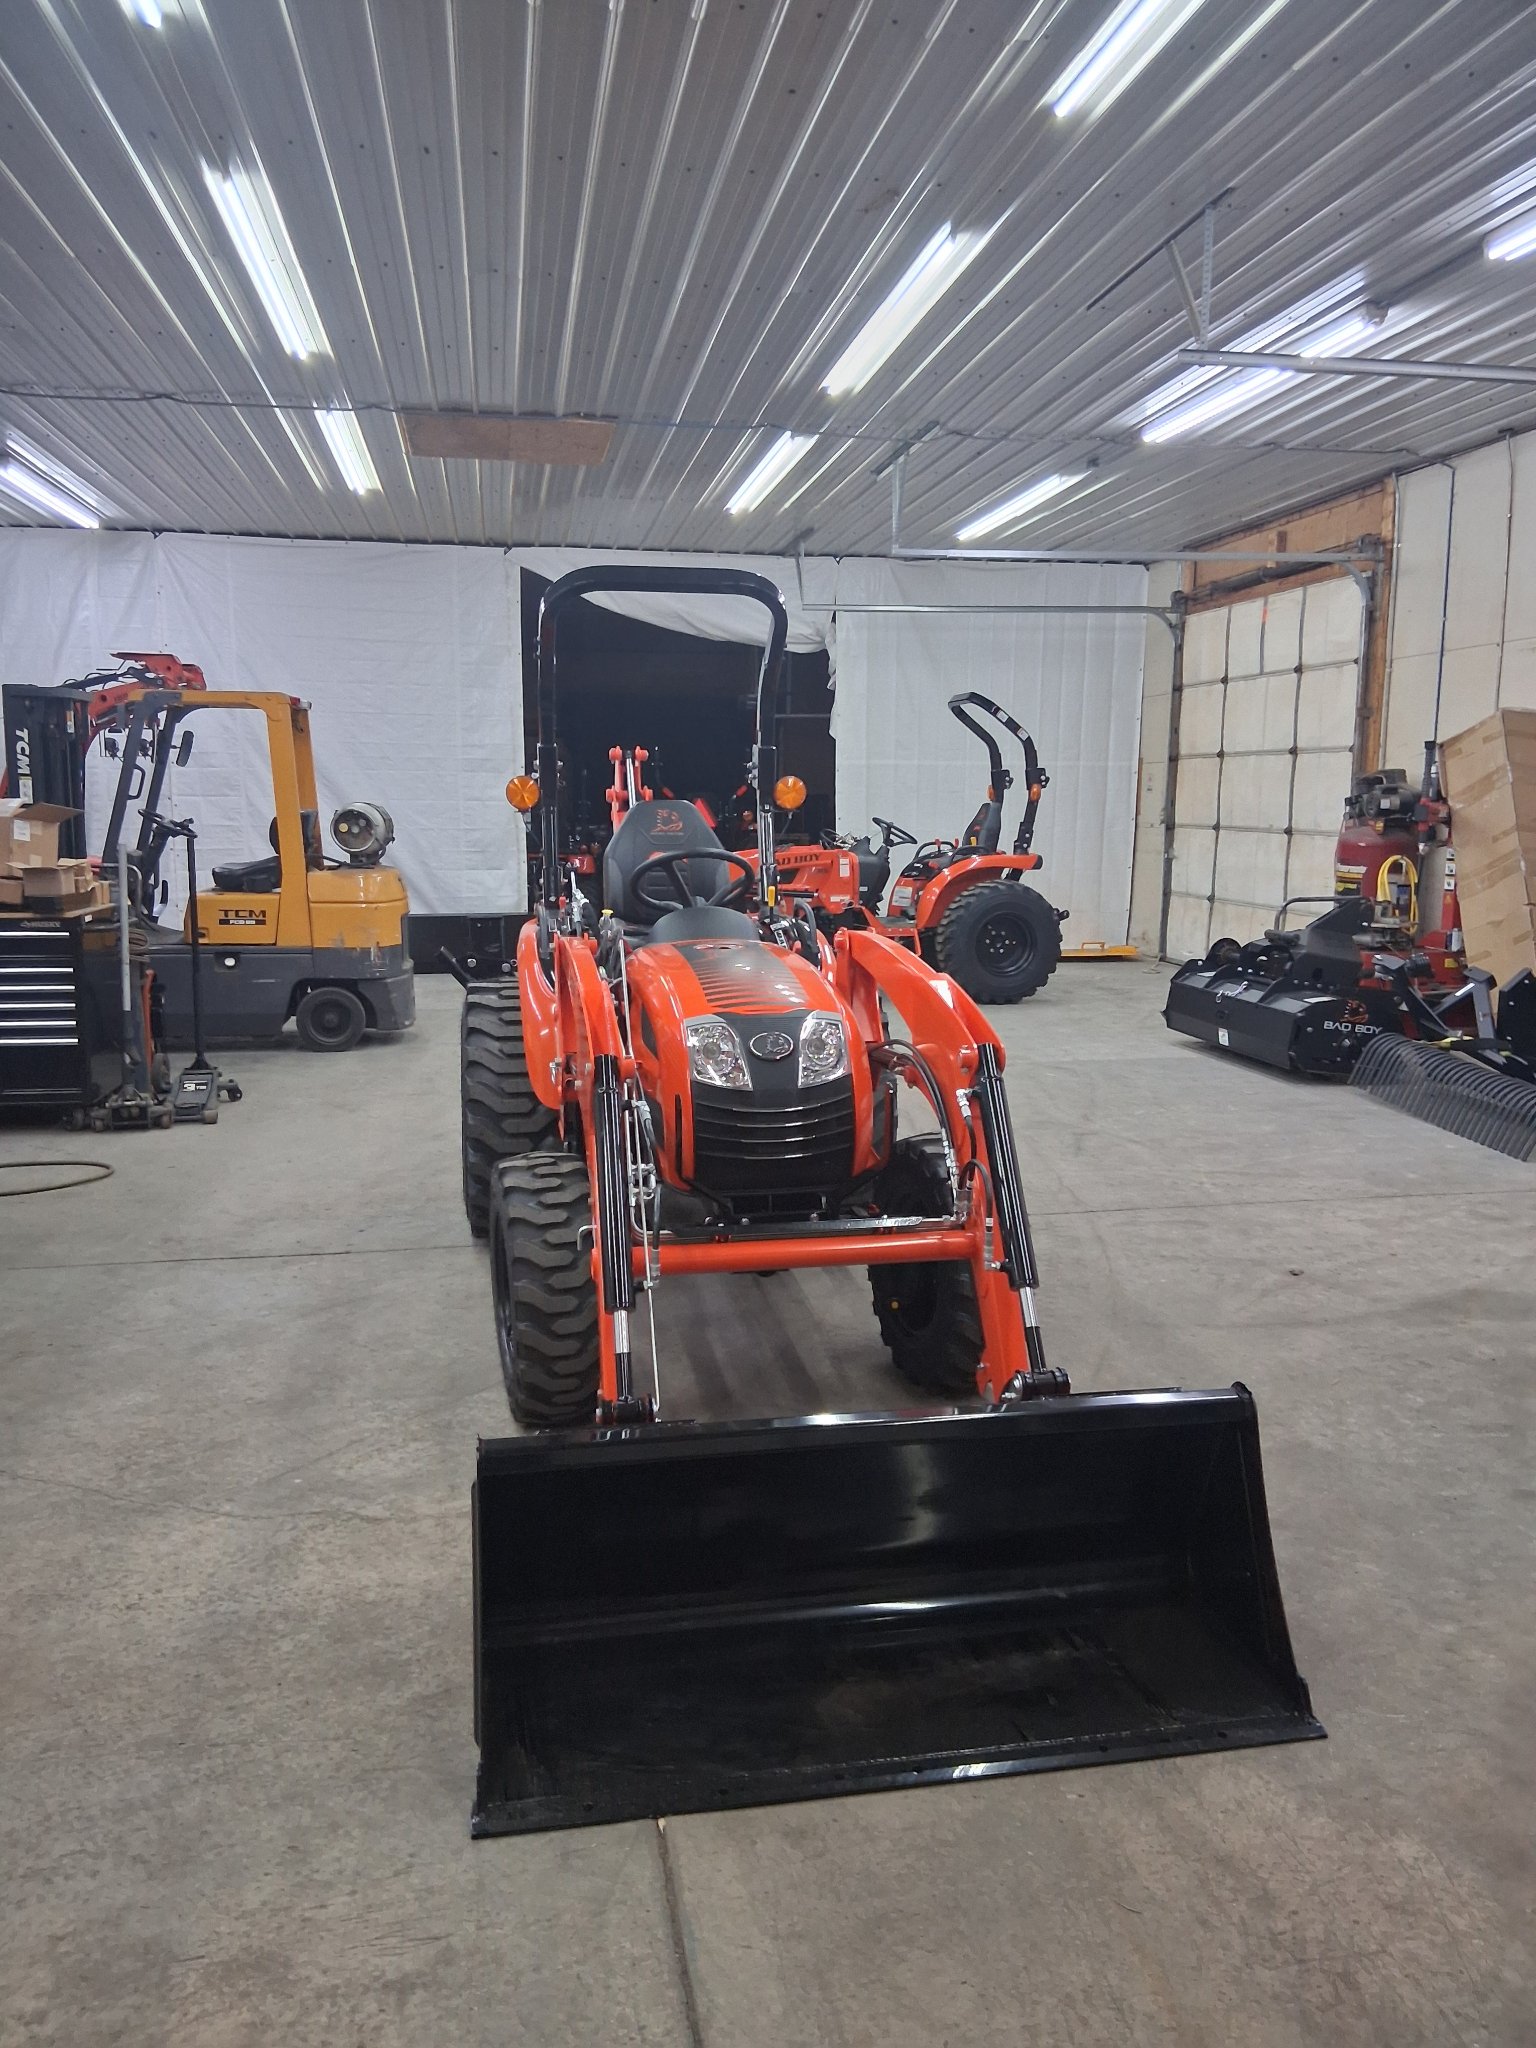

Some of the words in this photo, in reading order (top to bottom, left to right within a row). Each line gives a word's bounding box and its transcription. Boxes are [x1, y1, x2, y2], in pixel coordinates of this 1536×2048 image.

[15, 727, 31, 775] TCM
[218, 909, 267, 919] TCM
[1323, 1020, 1352, 1032] BAD
[1354, 1023, 1383, 1035] BOY
